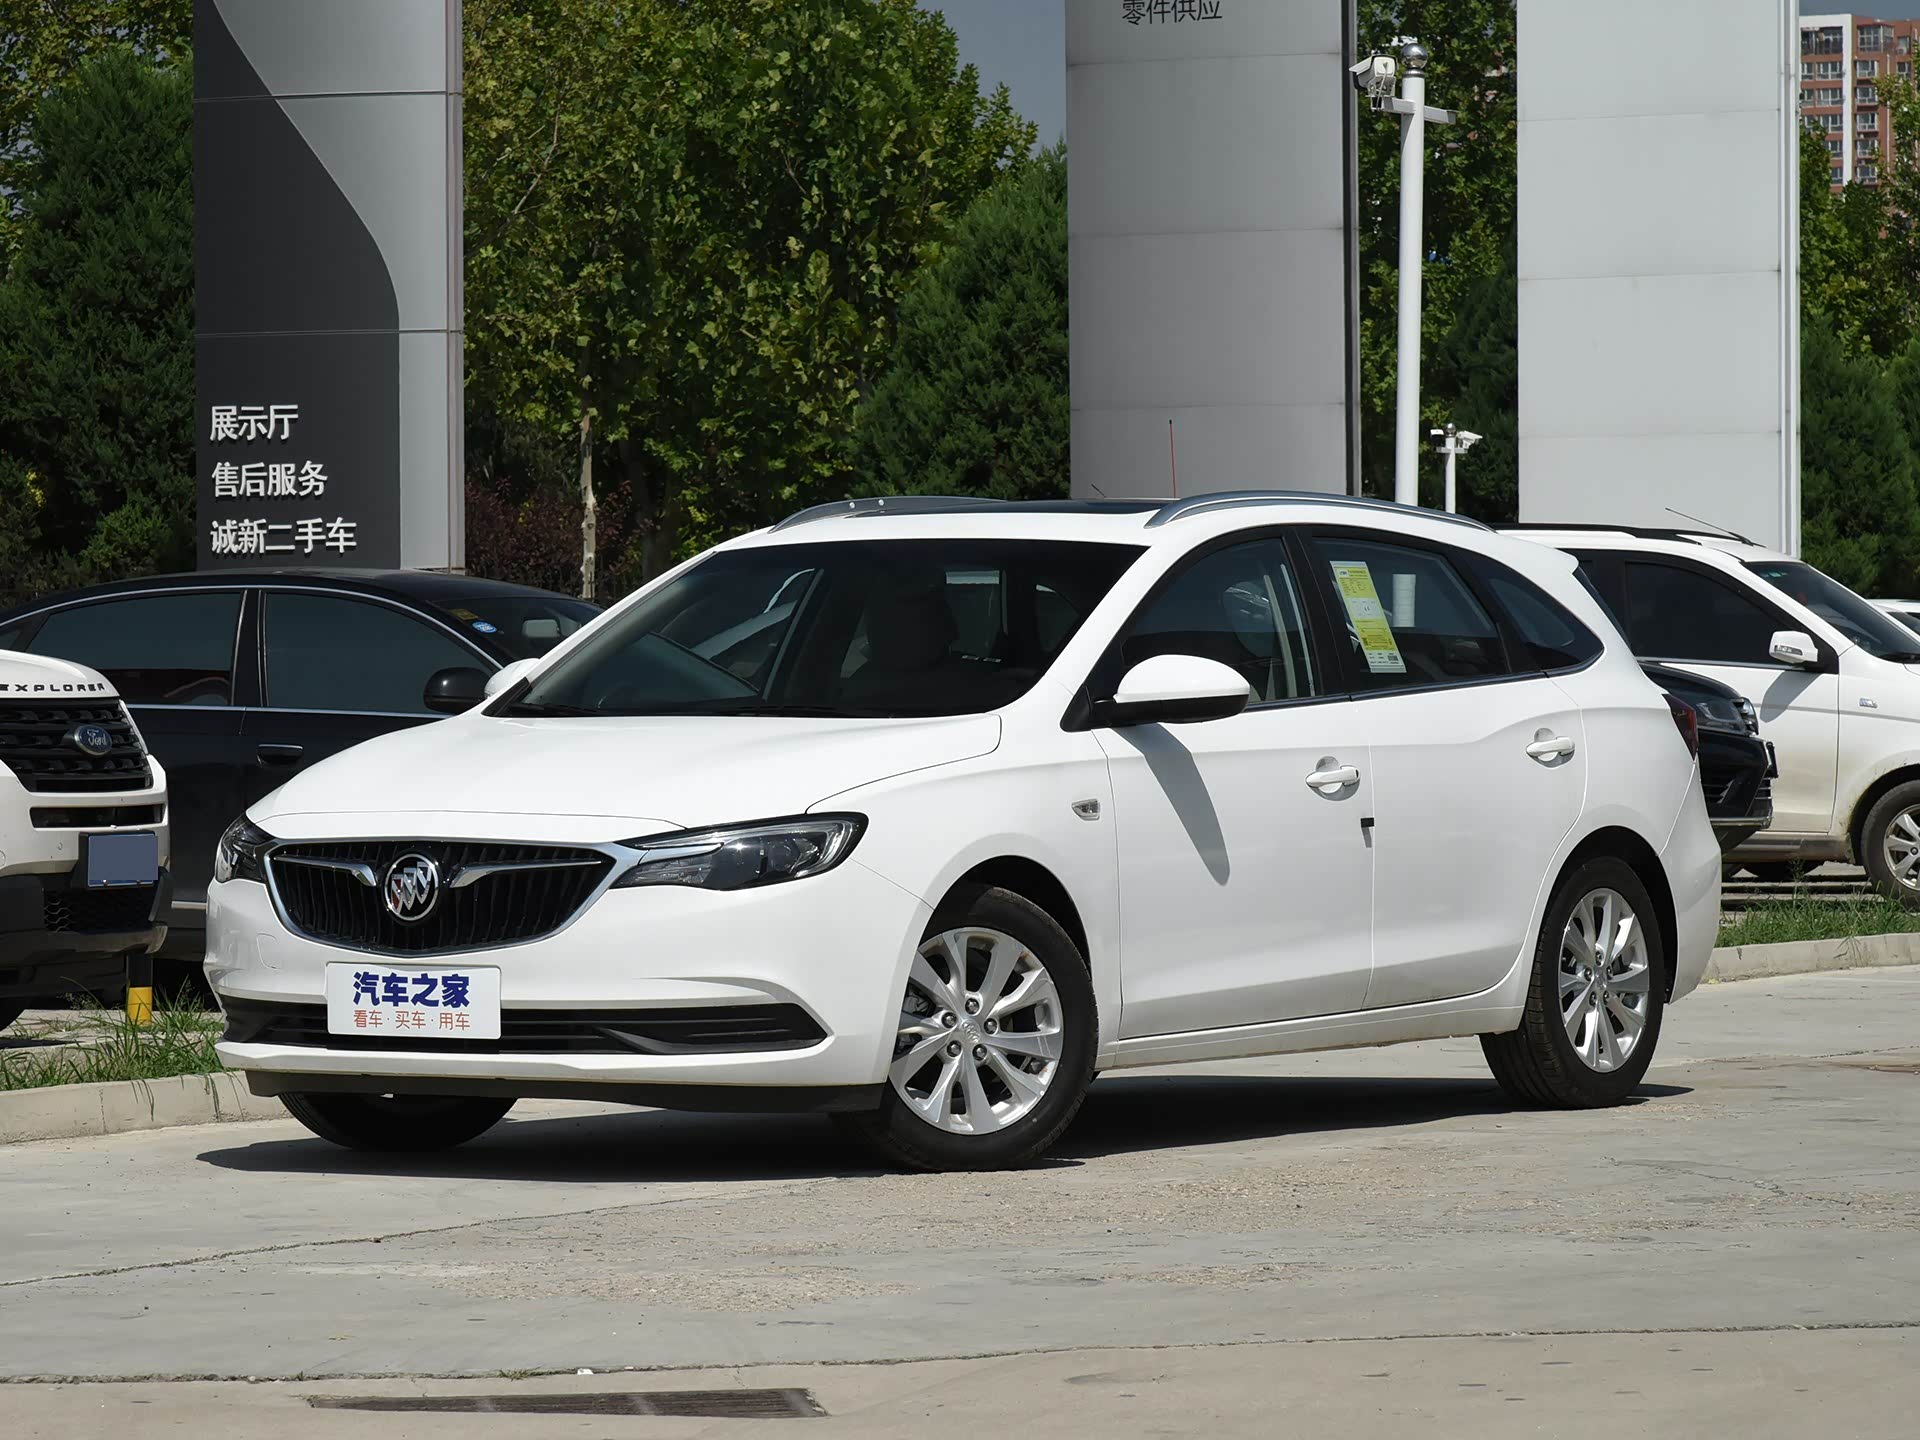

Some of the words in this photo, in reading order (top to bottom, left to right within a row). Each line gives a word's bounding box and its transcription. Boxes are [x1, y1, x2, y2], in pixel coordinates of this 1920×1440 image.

[1122, 0, 1222, 25] 零件供应
[210, 404, 299, 441] 展示厅
[211, 460, 328, 497] 售后服务
[210, 517, 357, 554] 诚新二手车
[0, 683, 105, 692] EXPLORER
[86, 728, 108, 746] Ford
[353, 971, 470, 1008] 汽车之家
